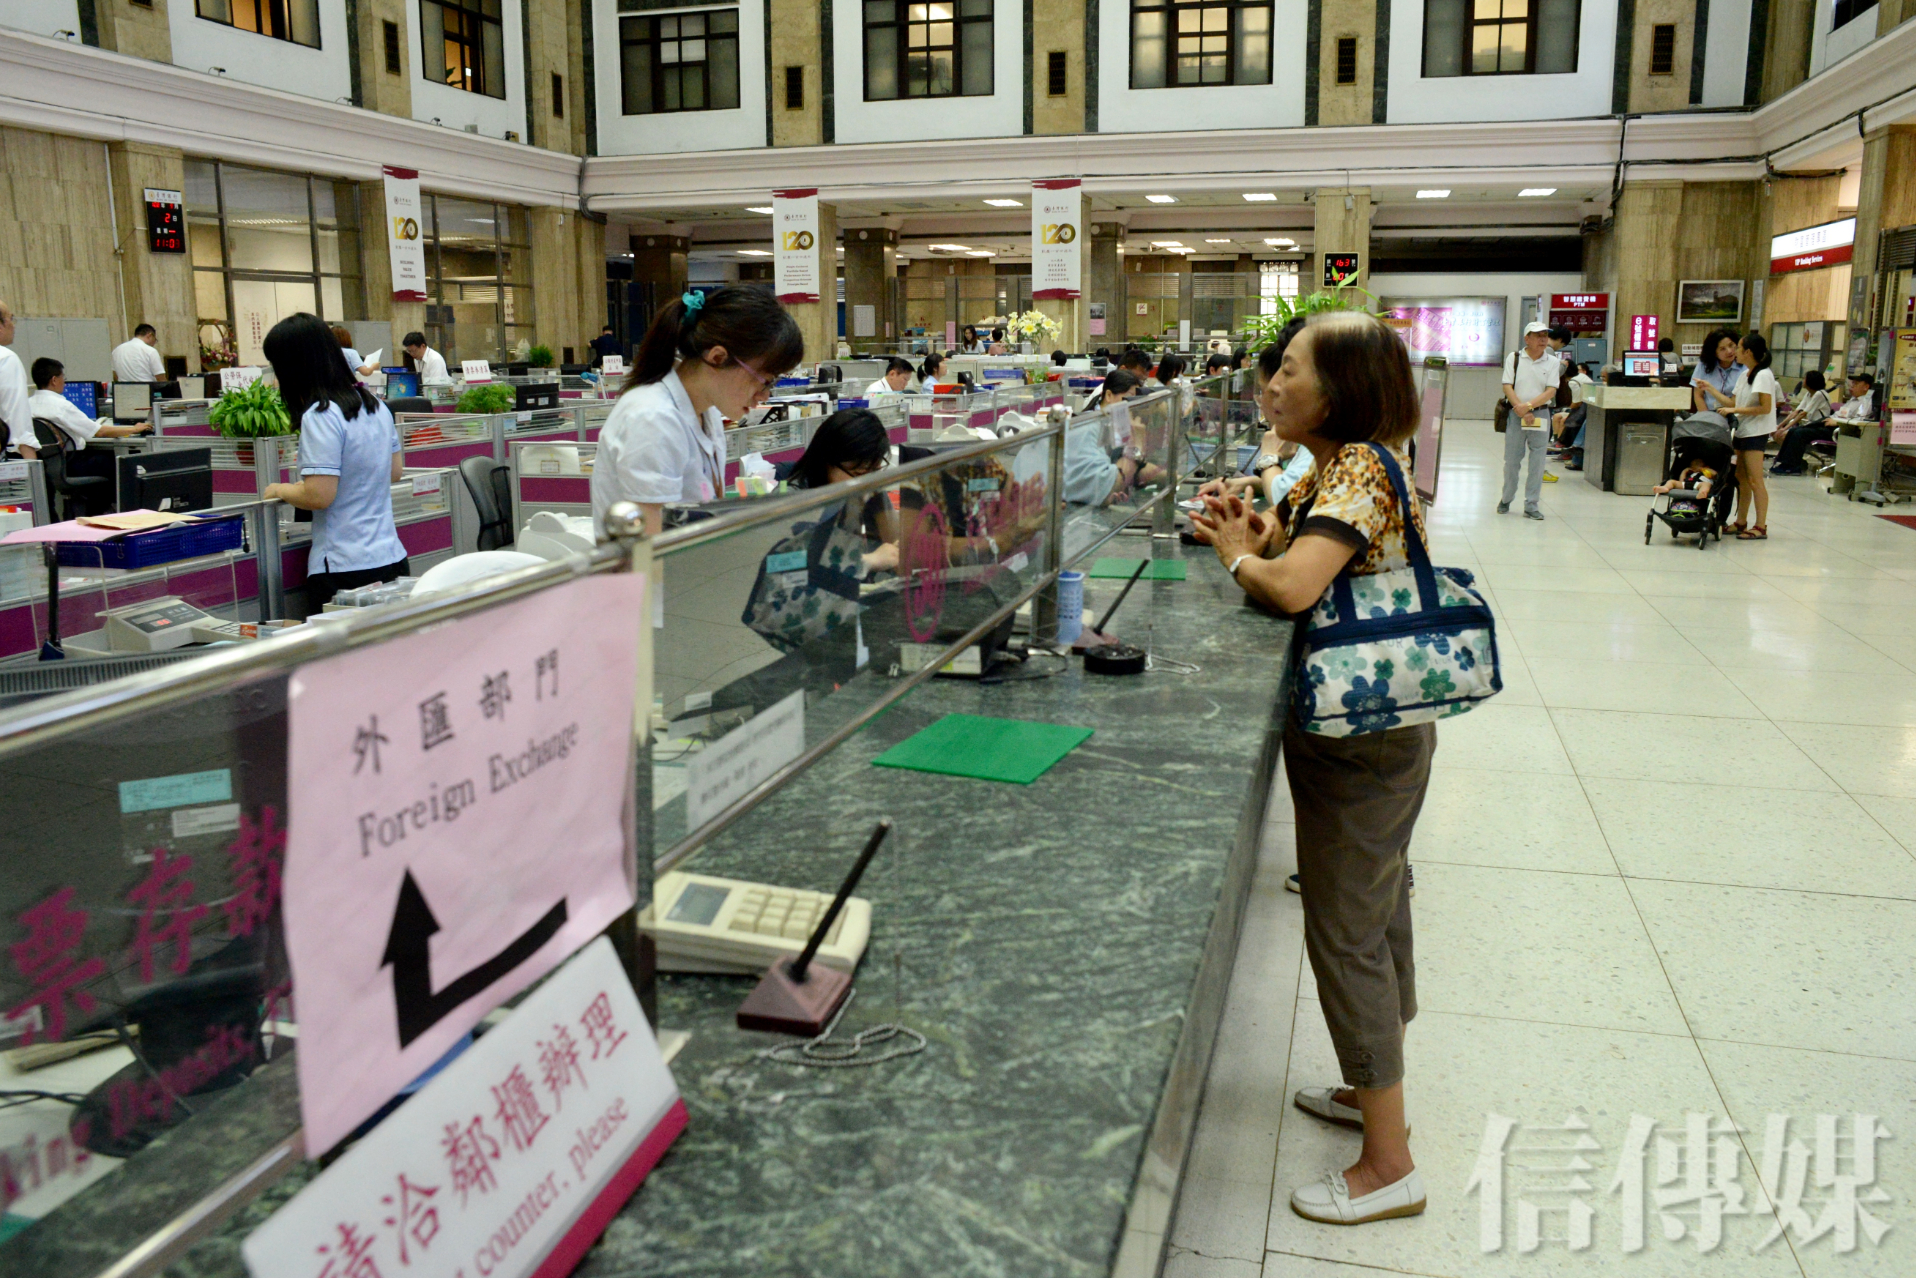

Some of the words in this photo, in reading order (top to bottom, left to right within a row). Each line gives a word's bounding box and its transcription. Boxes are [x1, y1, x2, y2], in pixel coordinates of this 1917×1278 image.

[393, 216, 418, 240] 120
[782, 231, 814, 251] 120
[1041, 223, 1076, 244] 120
[353, 648, 559, 776] 外匯部門
[357, 778, 476, 858] Foreign
[488, 721, 579, 794] Exchange
[568, 1096, 629, 1182] please
